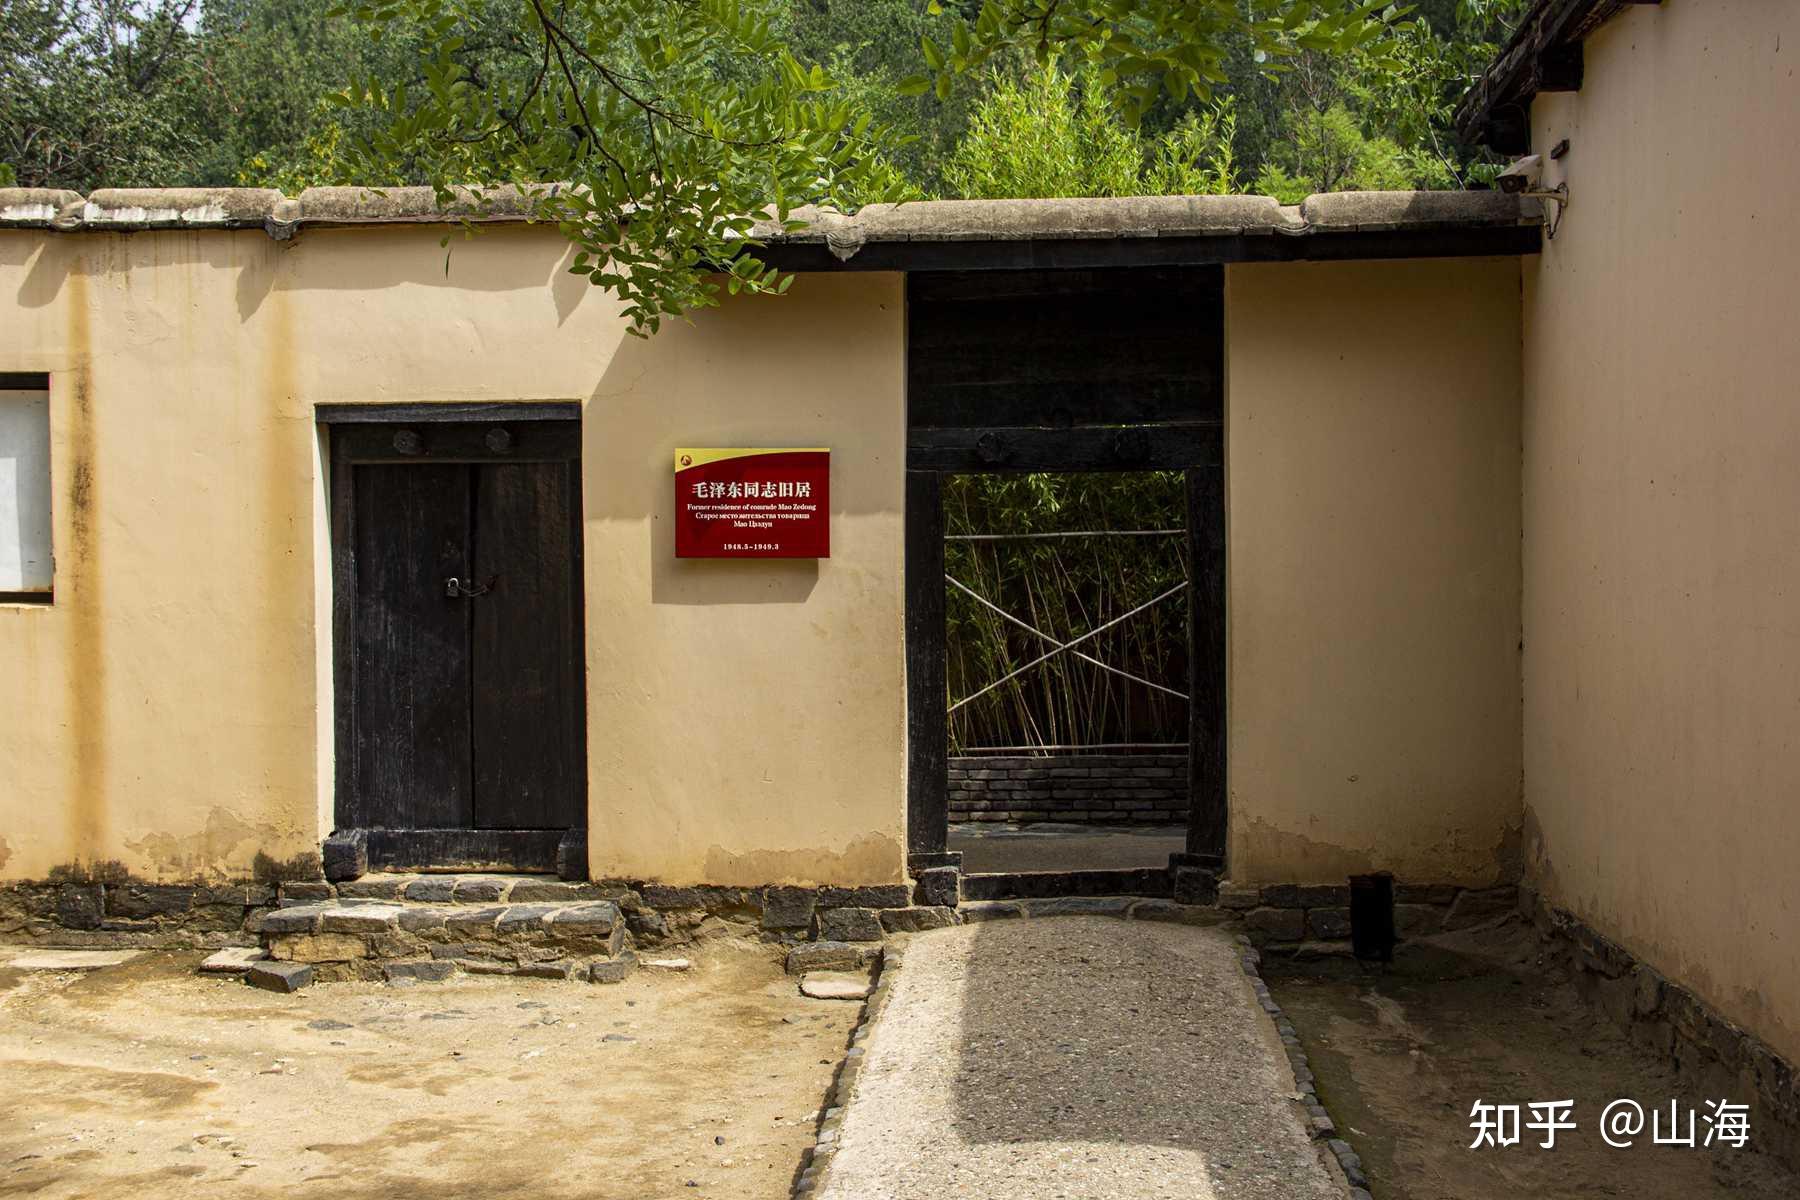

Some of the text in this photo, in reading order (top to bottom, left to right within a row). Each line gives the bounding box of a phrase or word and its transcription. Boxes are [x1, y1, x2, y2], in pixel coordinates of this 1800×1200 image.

[692, 482, 811, 498] 毛泽东同志旧居
